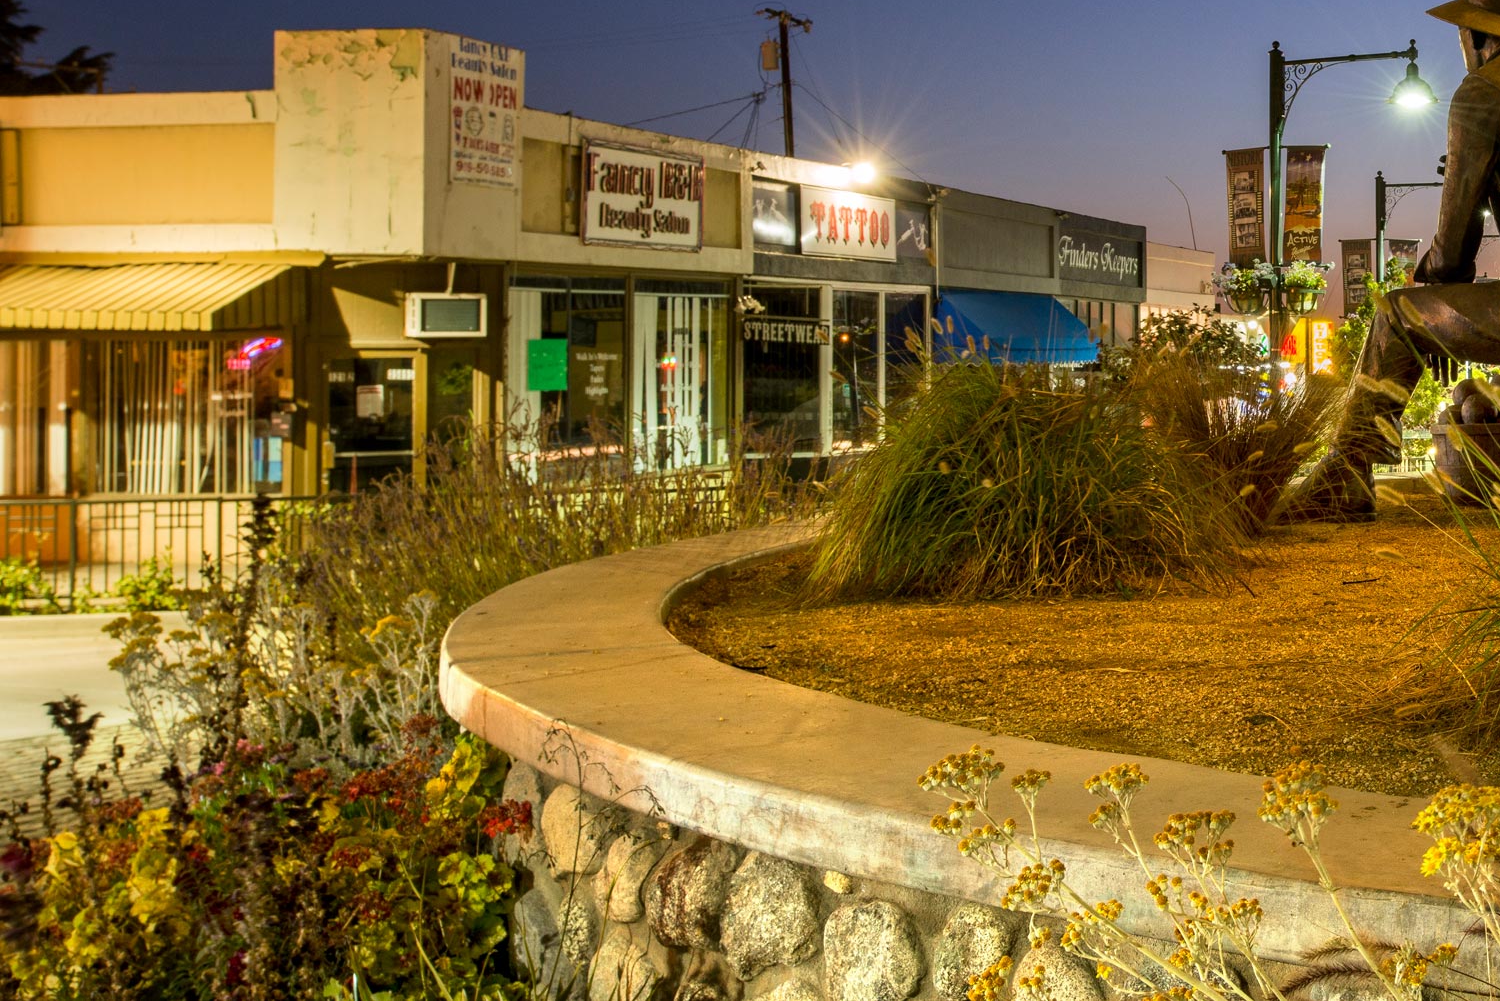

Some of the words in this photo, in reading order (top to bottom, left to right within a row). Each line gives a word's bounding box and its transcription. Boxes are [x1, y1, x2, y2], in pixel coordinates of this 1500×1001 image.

[454, 76, 485, 104] NOW
[586, 152, 655, 210] Fancy
[659, 161, 706, 202] B&B
[599, 202, 653, 239] Beauty
[653, 209, 690, 235] Salon
[810, 200, 891, 249] TATTOO
[1058, 235, 1099, 271] Finders
[1101, 242, 1139, 281] Keepers
